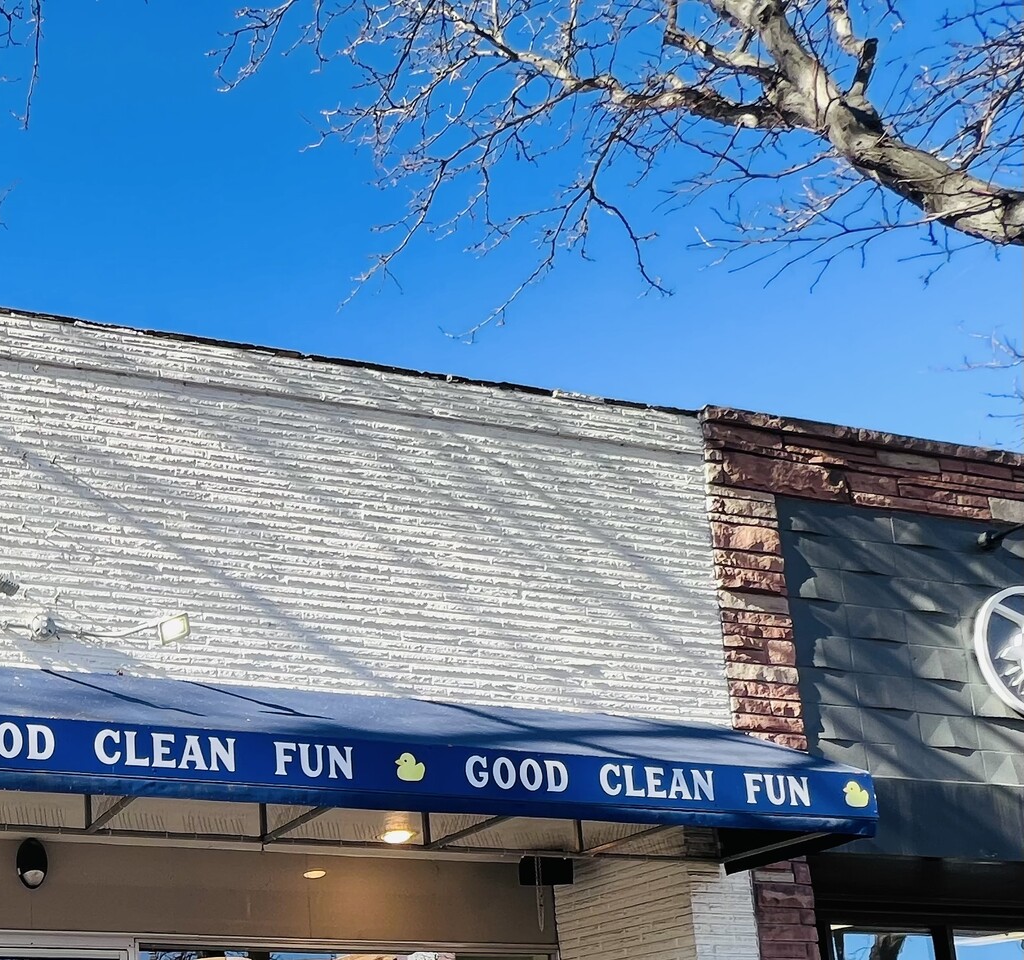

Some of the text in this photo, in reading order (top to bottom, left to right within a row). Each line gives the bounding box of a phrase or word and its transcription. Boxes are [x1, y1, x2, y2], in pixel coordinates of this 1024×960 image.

[94, 728, 237, 773] CLEAN
[273, 741, 354, 781] FUN
[465, 755, 812, 808] GOOD CLEAN FUN
